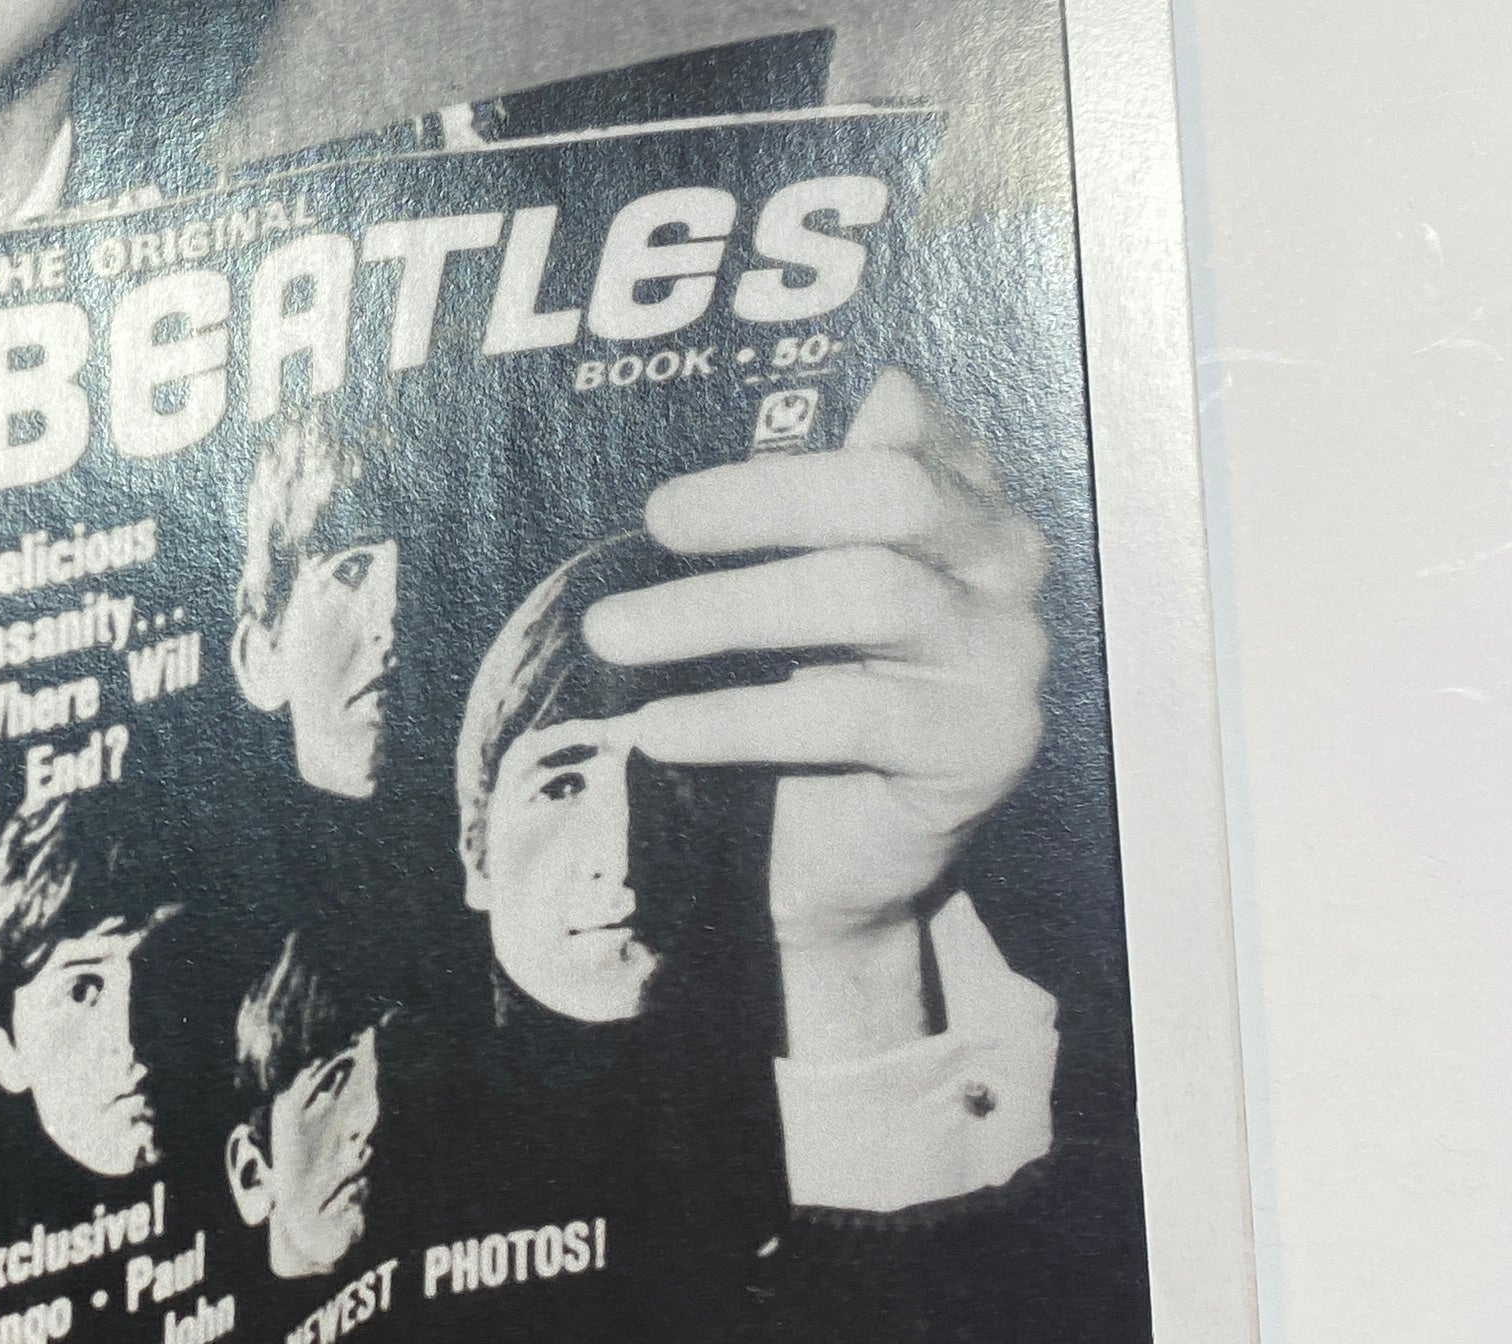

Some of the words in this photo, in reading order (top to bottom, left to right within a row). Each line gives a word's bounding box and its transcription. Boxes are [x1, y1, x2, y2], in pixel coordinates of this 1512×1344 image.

[90, 194, 318, 278] ORIGINAL
[575, 346, 718, 390] BOOK
[128, 631, 200, 704] Will
[21, 725, 129, 809] End?
[125, 1233, 206, 1313] Paul
[423, 1218, 607, 1298] PHOTOS!
